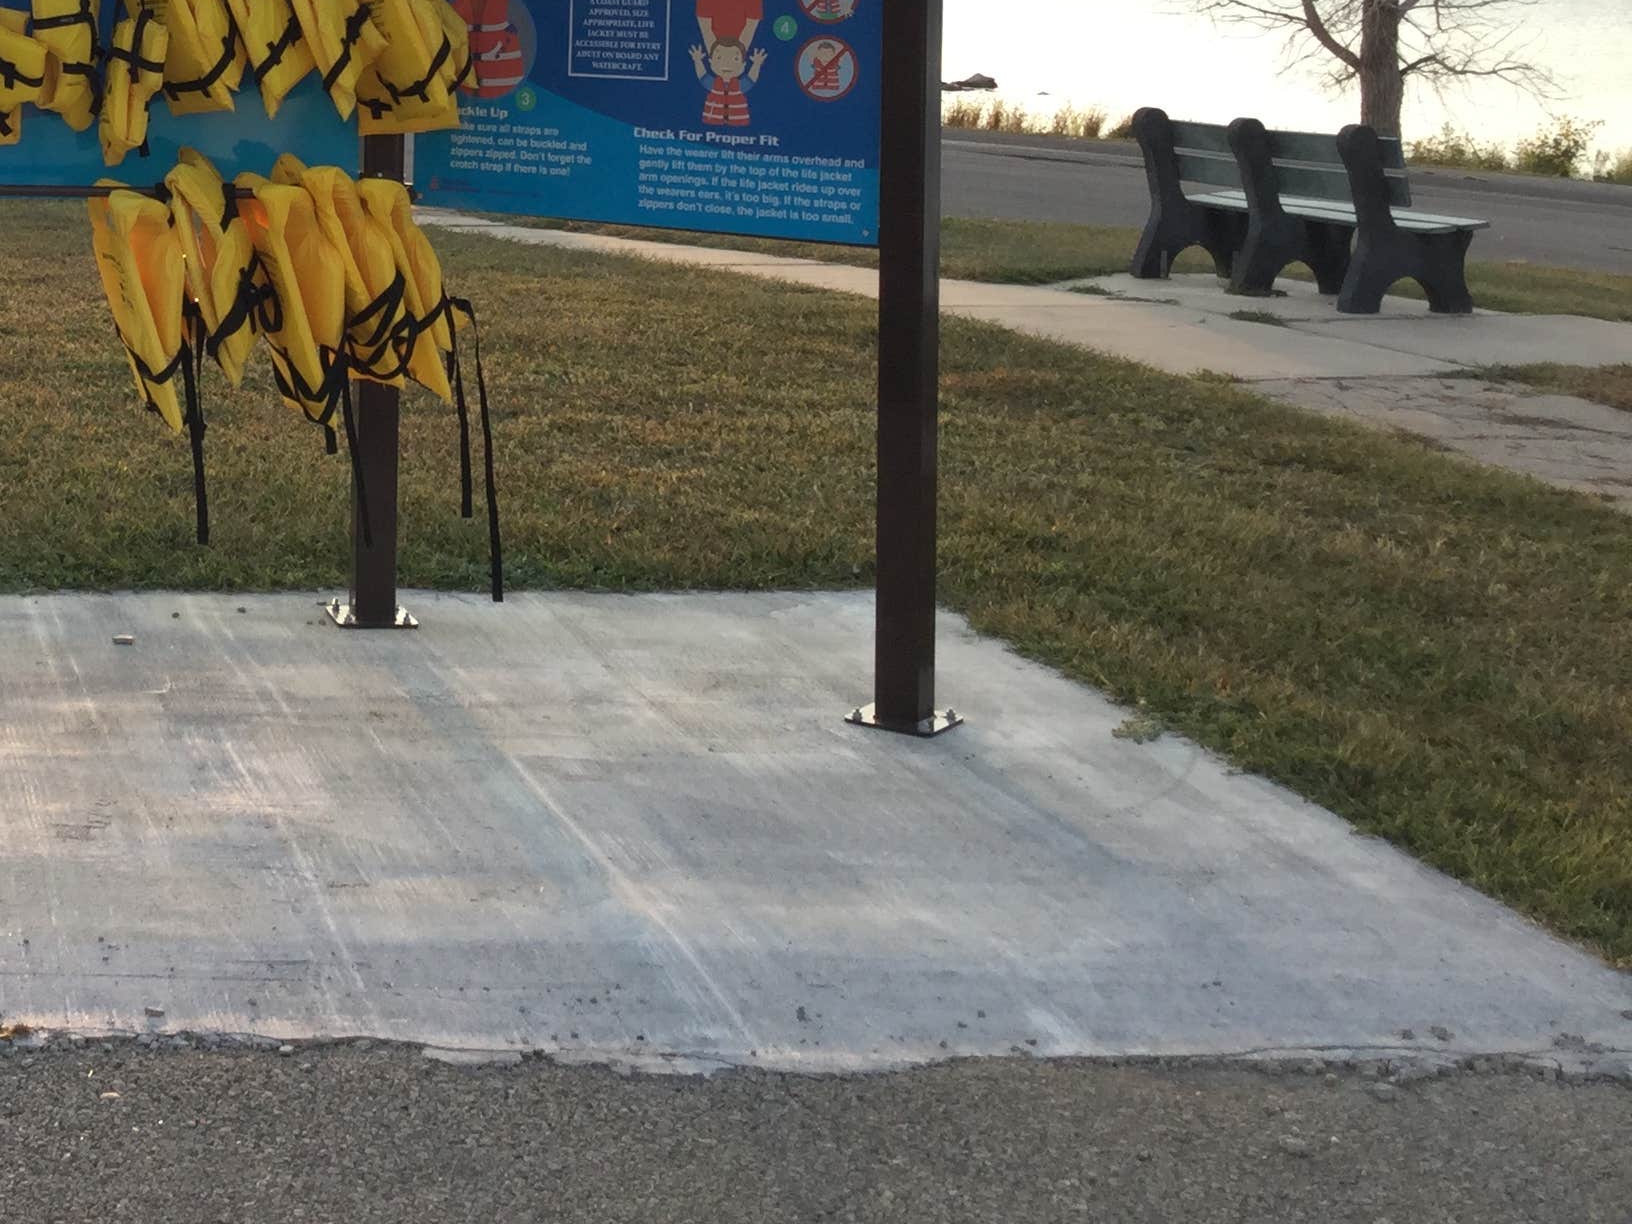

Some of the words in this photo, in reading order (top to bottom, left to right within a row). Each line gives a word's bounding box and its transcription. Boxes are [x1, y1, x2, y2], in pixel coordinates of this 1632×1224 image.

[780, 22, 790, 33] 4
[521, 92, 530, 105] 3
[458, 106, 488, 117] ckle
[490, 108, 508, 120] Up
[634, 128, 675, 140] Check
[679, 130, 703, 142] For
[706, 132, 756, 146] Proper
[760, 134, 780, 146] Fit
[639, 144, 664, 155] Have
[666, 146, 682, 156] the
[684, 150, 718, 158] wearer
[721, 148, 734, 160] lift
[737, 150, 760, 161] their
[762, 154, 790, 163] arms
[792, 155, 842, 167] overhead
[844, 158, 865, 168] and
[638, 159, 669, 172] gently
[672, 160, 684, 170] lift
[687, 161, 712, 172] them
[715, 163, 728, 175] by
[730, 164, 746, 174] the
[748, 166, 765, 178] top
[768, 166, 779, 176] of
[782, 168, 798, 178] the
[801, 168, 817, 179] life
[820, 169, 852, 182] jacket
